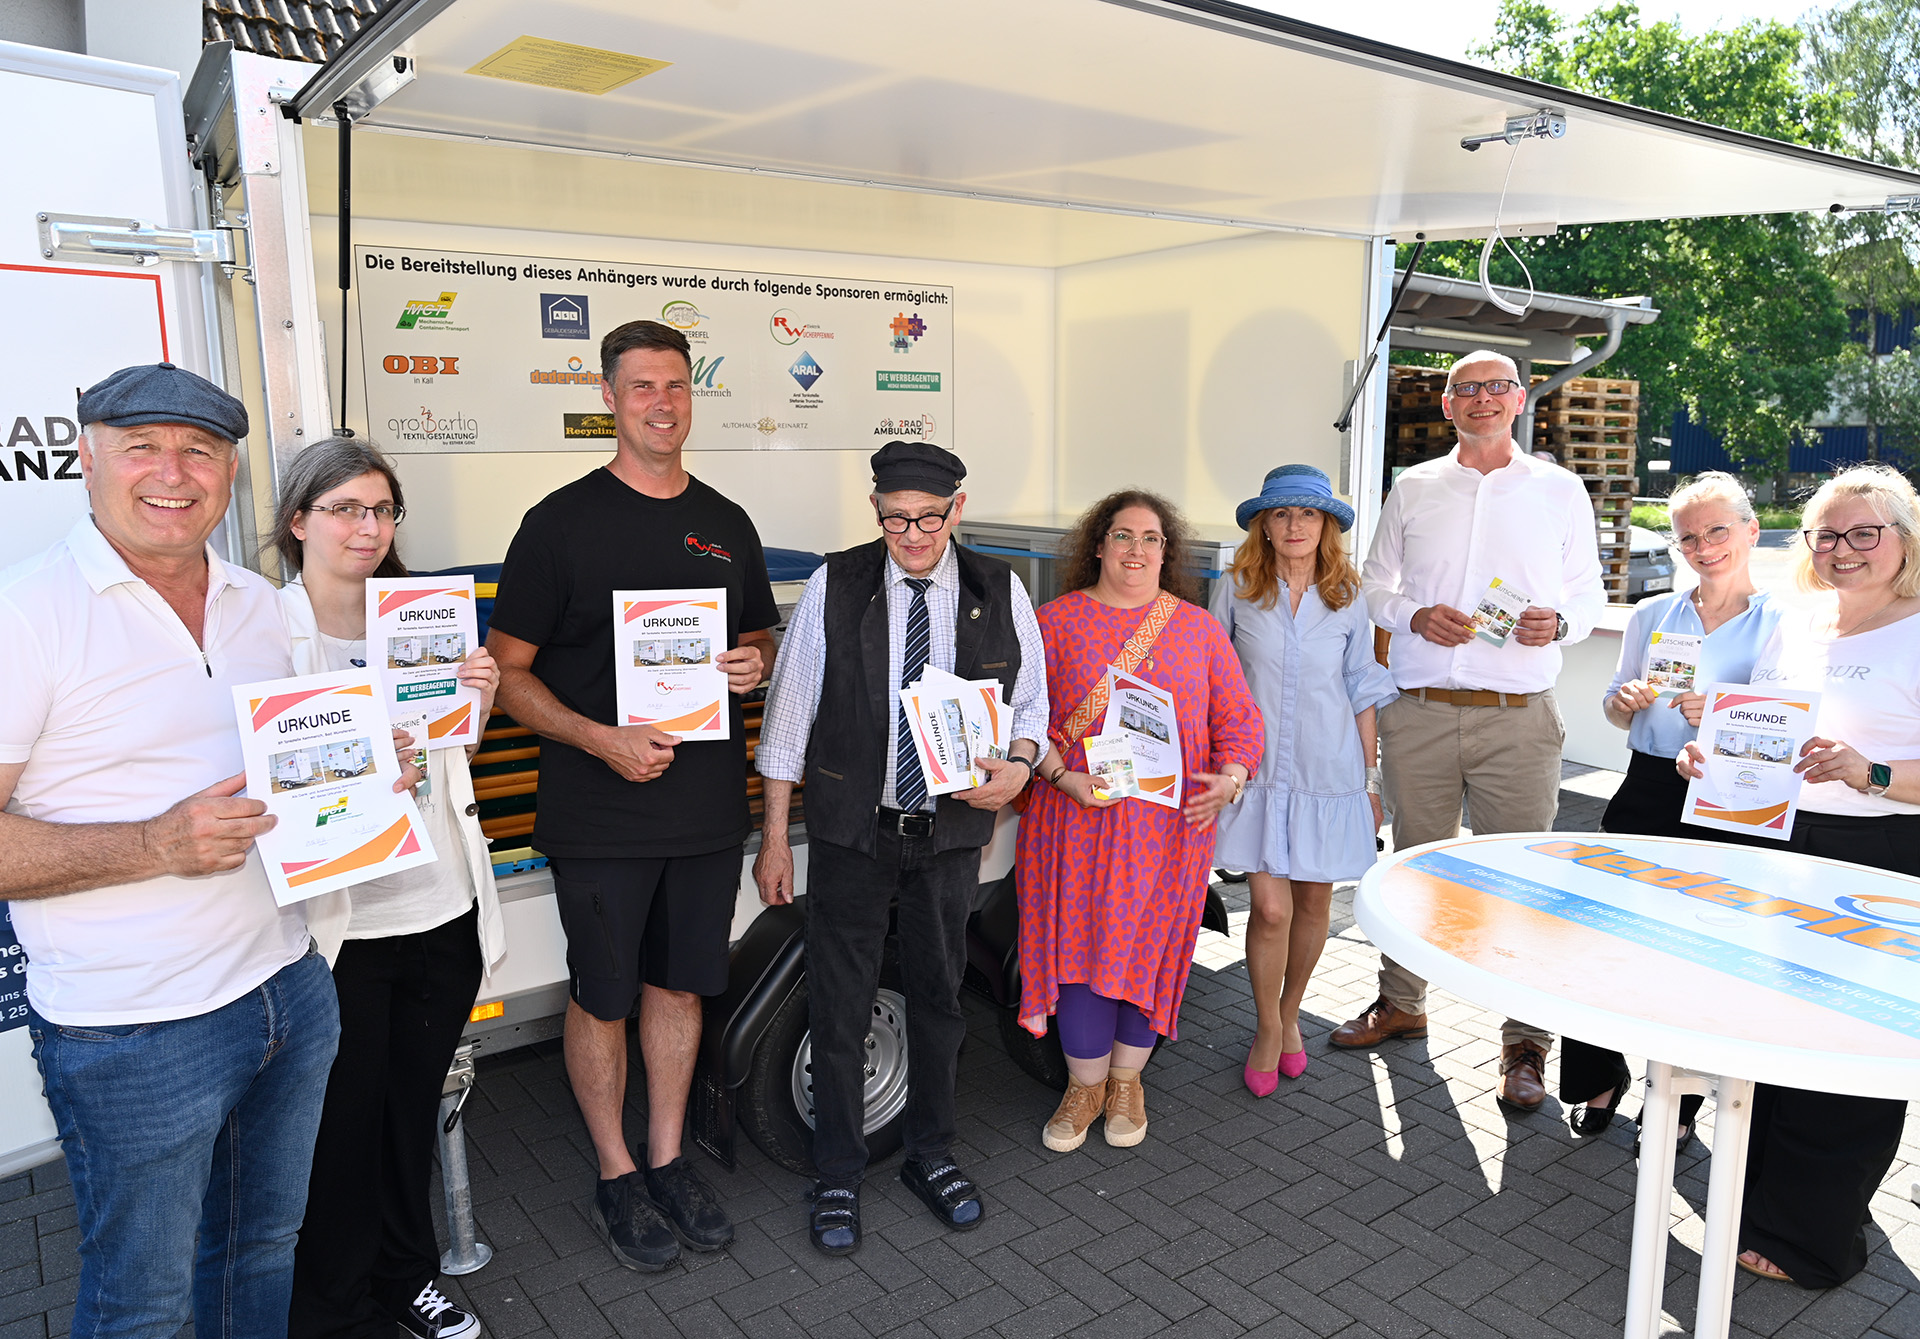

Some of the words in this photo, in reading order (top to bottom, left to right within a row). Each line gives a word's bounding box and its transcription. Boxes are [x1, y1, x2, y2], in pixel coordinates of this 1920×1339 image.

[365, 254, 395, 271] Die
[401, 256, 518, 281] Bereitstellung
[523, 264, 572, 281] dieses
[577, 268, 658, 288] Anhängers
[662, 275, 707, 289] wurde
[711, 276, 750, 292] durch
[754, 279, 812, 297] folgende
[816, 284, 880, 301] Sponsoren
[884, 290, 949, 305] ermöglicht:
[407, 303, 447, 316] MCT
[383, 355, 459, 375] OBI
[792, 365, 820, 376] ARAL
[530, 369, 603, 385] dederichs
[878, 373, 889, 382] DIE
[890, 374, 939, 383] WERBEAGENTUR
[899, 420, 922, 428] 2RAD
[566, 427, 617, 437] Recycling
[874, 428, 922, 436] AMBULANZ
[399, 608, 456, 622] URKUNDE
[643, 617, 700, 628] URKUNDE
[1657, 638, 1695, 648] GUTSCHEINE
[398, 686, 409, 694] DIE
[410, 680, 456, 693] WERBEAGENTUR
[1125, 692, 1160, 713] URKUNDE
[278, 709, 352, 733] URKUNDE
[1729, 710, 1788, 725] URKUNDE
[928, 711, 948, 765] URKUNDE
[1466, 868, 1566, 900] Fahrzeugteile
[1584, 904, 1722, 949] Industriebedarf
[1524, 840, 1920, 963] dederic
